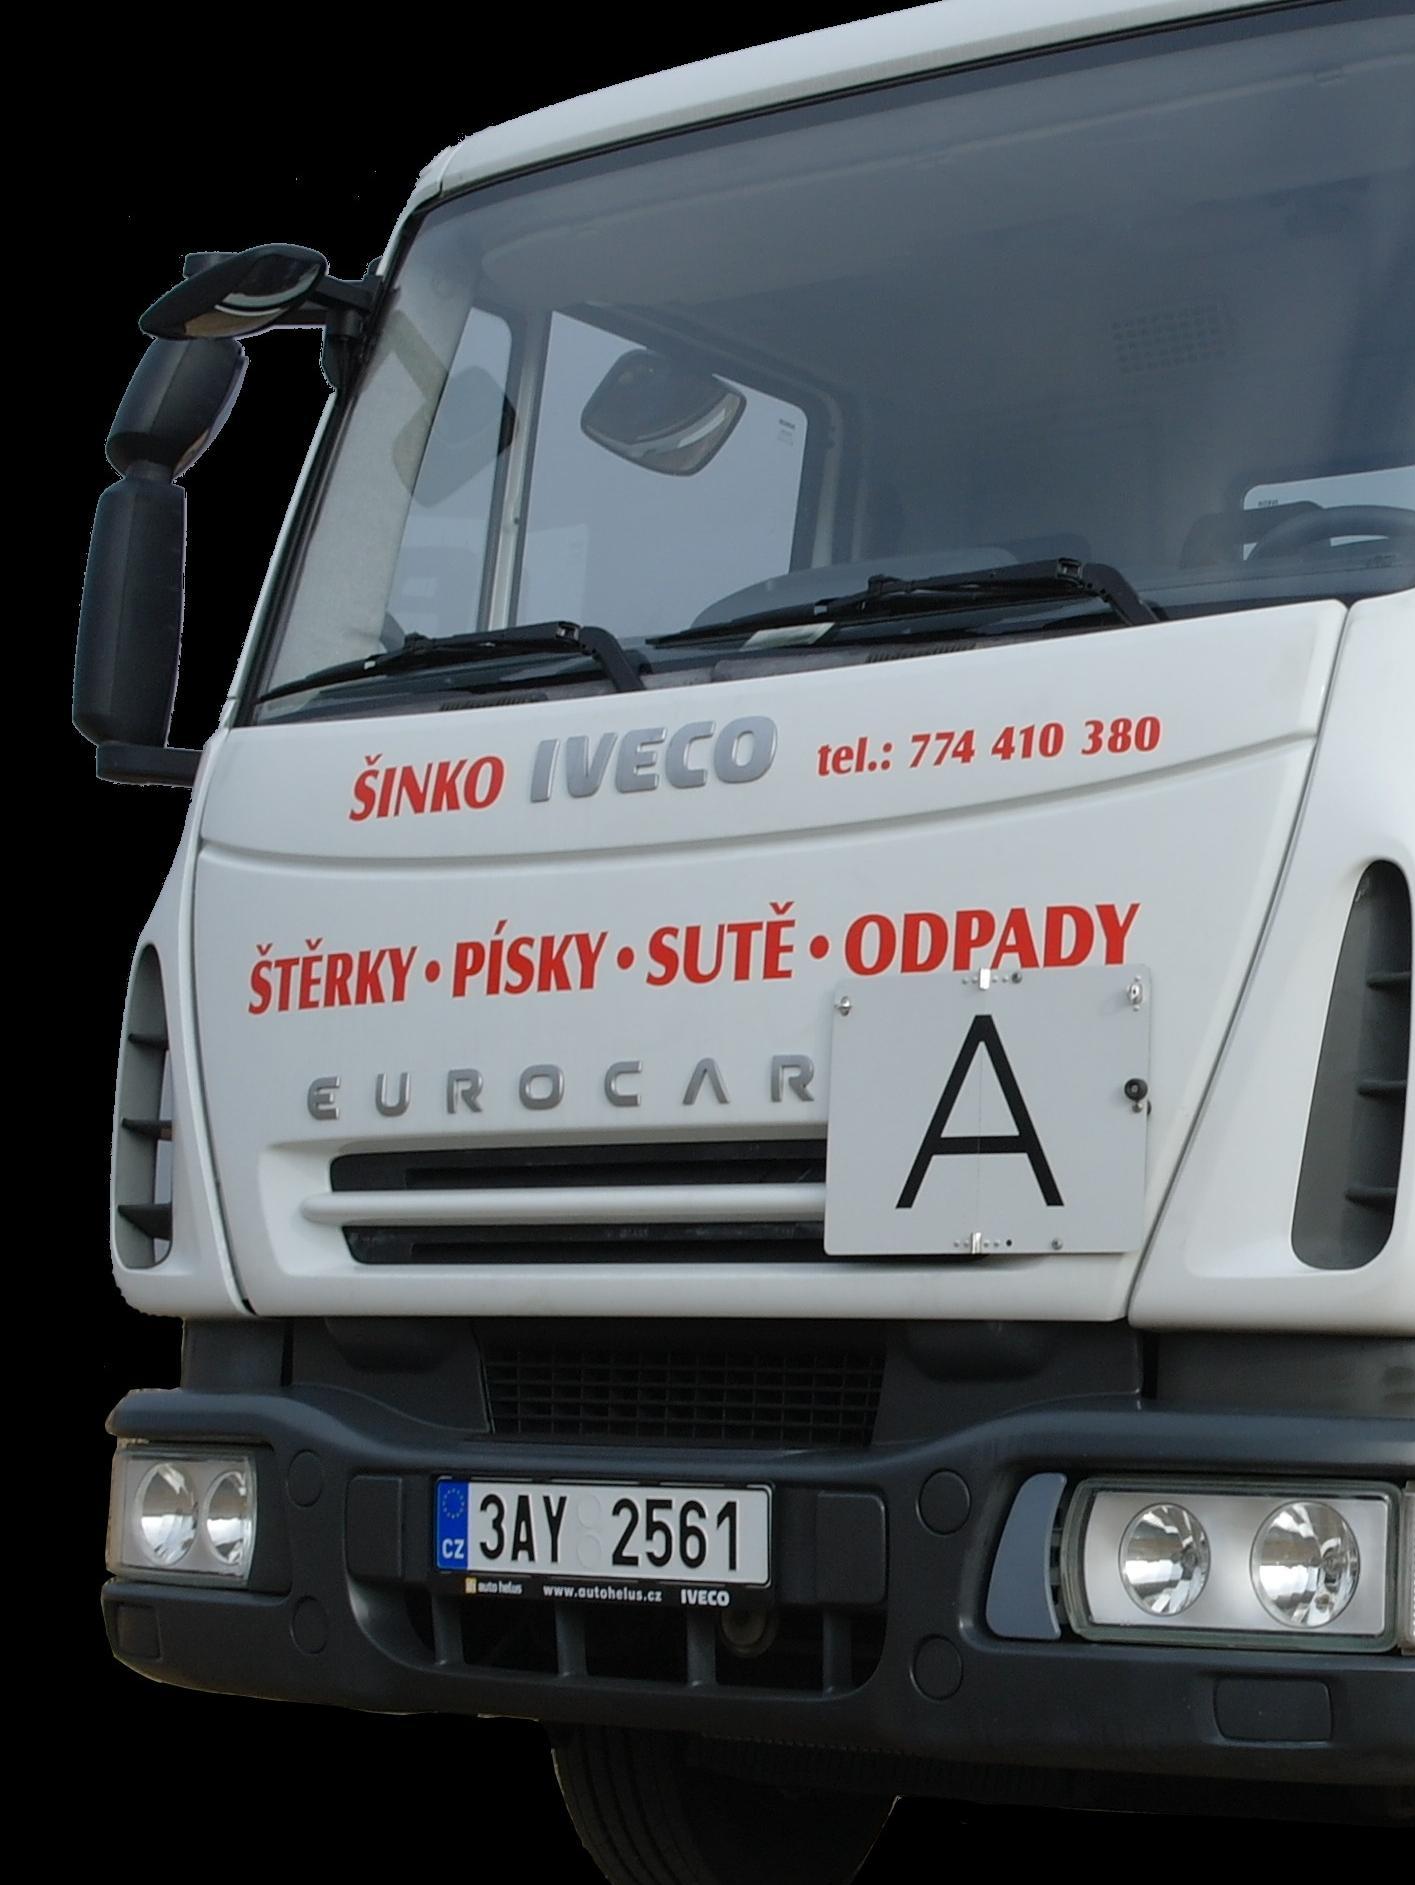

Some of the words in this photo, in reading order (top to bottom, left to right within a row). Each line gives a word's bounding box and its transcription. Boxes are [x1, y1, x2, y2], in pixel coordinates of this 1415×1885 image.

[530, 716, 778, 803] IVECO
[816, 736, 894, 778] tel.:
[910, 729, 977, 768] 774
[990, 721, 1066, 761] 410
[1080, 715, 1163, 757] 380
[348, 754, 506, 822] ŠINKO
[248, 938, 418, 1016] ŠTĚRKY
[451, 919, 609, 998] PÍSKY
[645, 901, 797, 987] SUTĚ
[842, 902, 1141, 977] ODPADY
[895, 1014, 1066, 1210] A
[441, 1538, 465, 1560] CZ
[479, 1493, 568, 1564] 3AY
[611, 1498, 738, 1572] 2561
[543, 1585, 663, 1603] www.autohelus.cz
[680, 1588, 730, 1607] IVECO
